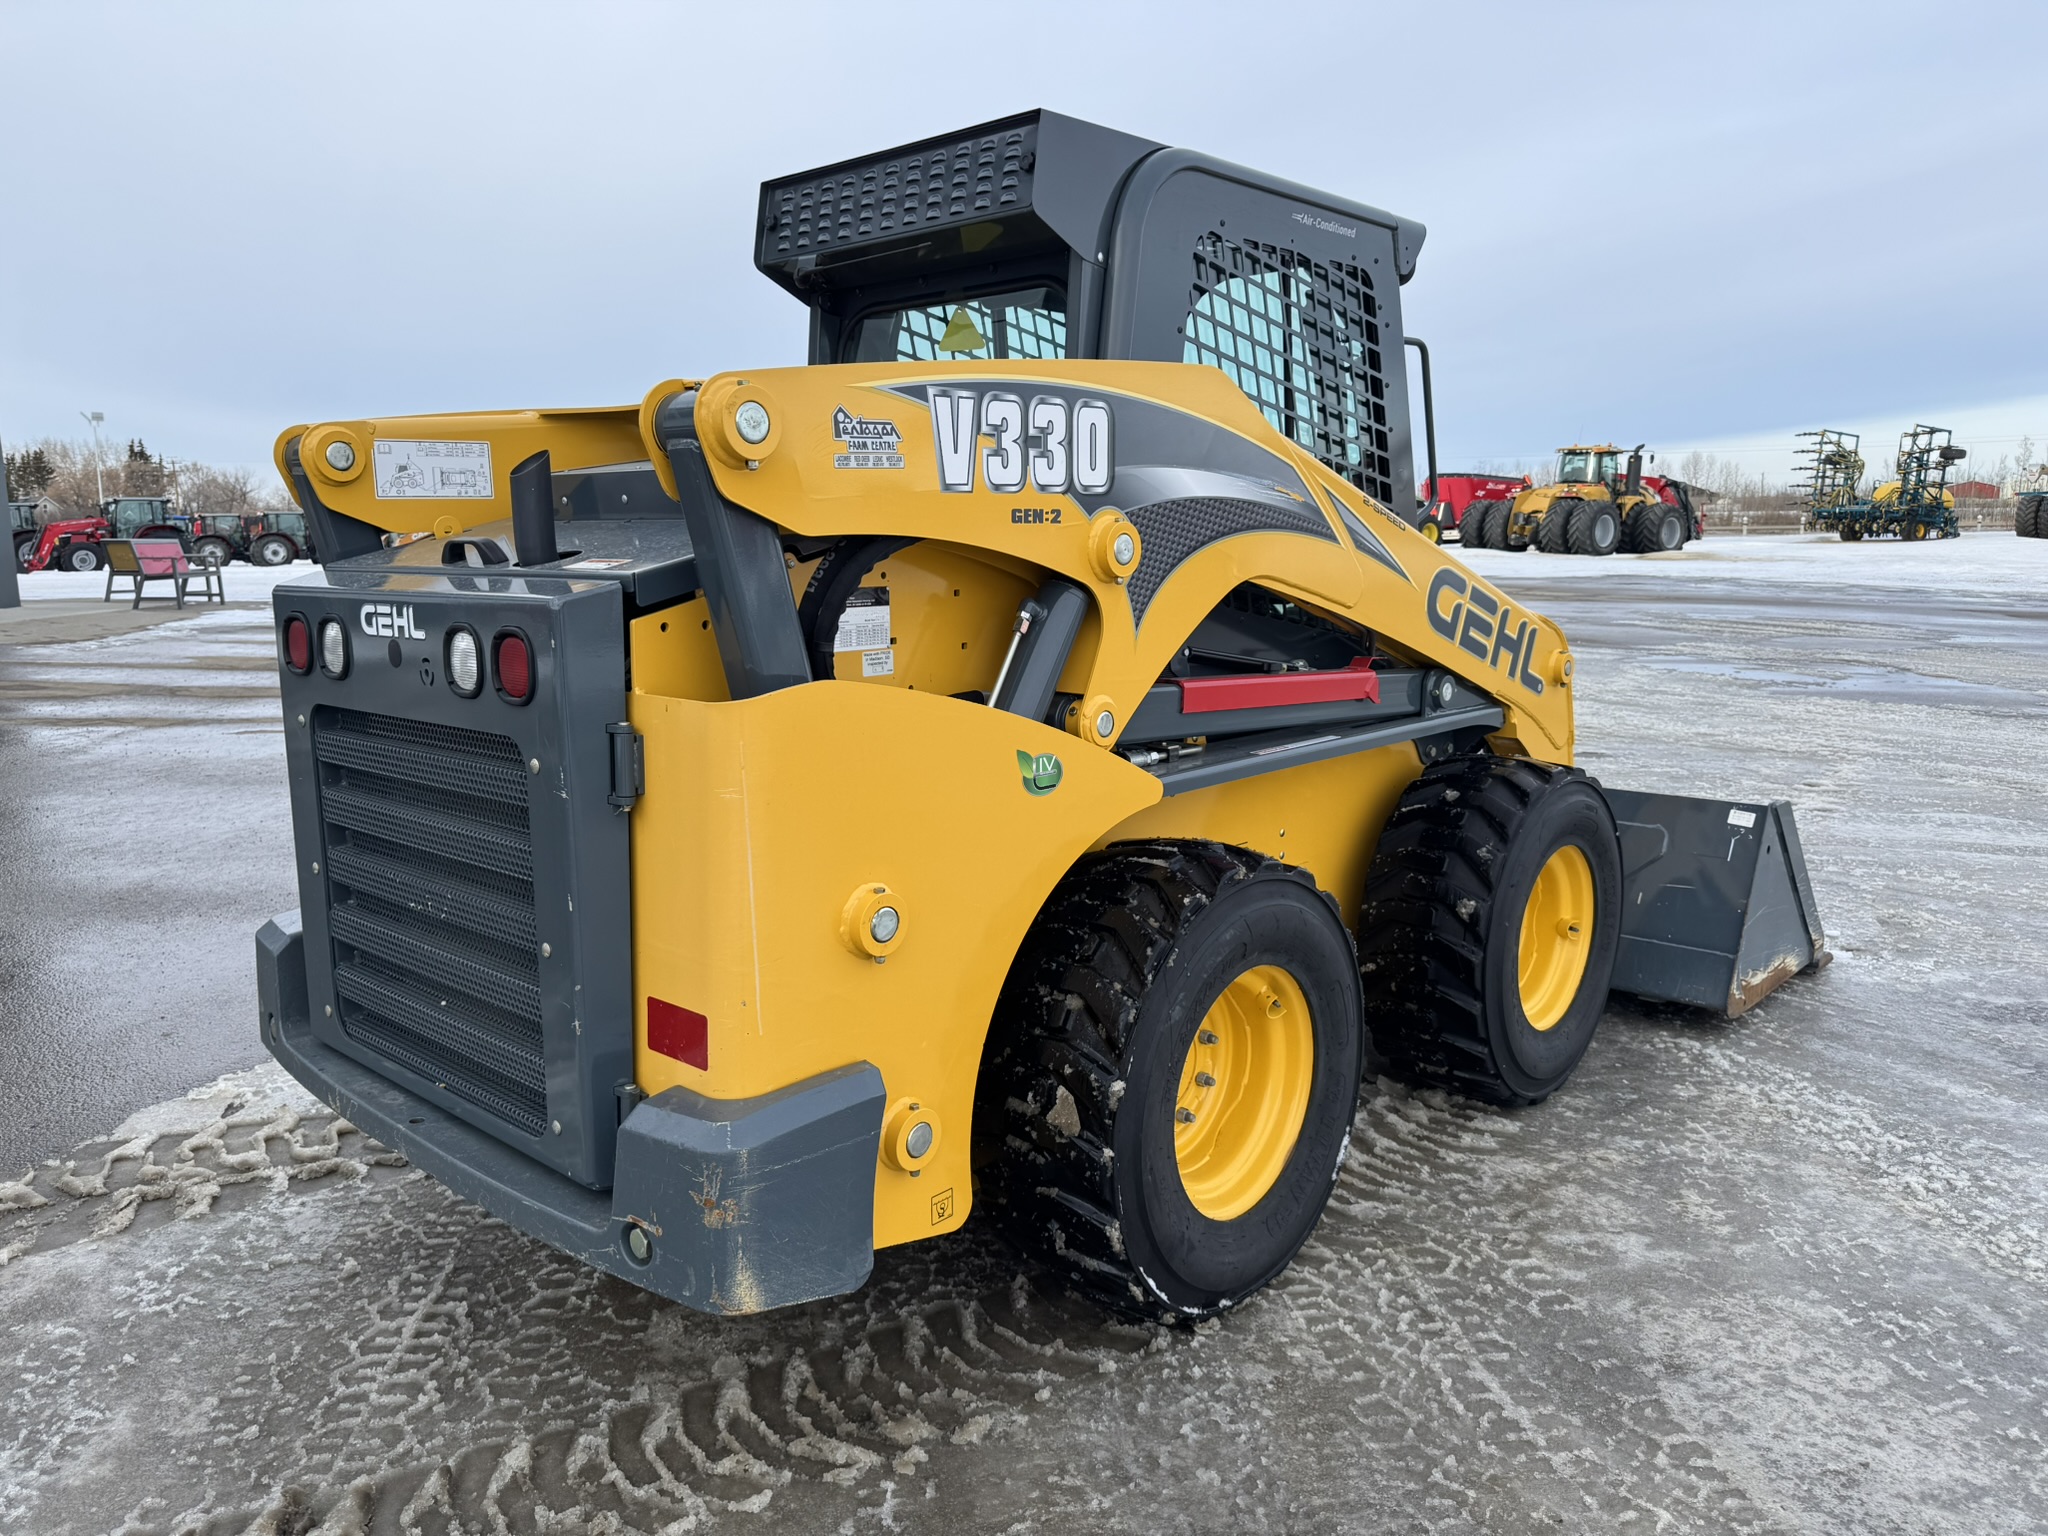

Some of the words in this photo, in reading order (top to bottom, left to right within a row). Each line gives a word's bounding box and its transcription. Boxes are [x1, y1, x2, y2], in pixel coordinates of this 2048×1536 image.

[1302, 213, 1357, 238] Air-Conditioned
[833, 406, 902, 440] Pentagon
[926, 385, 1114, 494] V330
[848, 440, 870, 451] FARM
[871, 441, 897, 451] CENTRE
[1011, 508, 1062, 524] GEN:2
[1362, 494, 1406, 532] 2-SPEED
[360, 603, 426, 640] GEHL
[1425, 565, 1544, 696] GEHL
